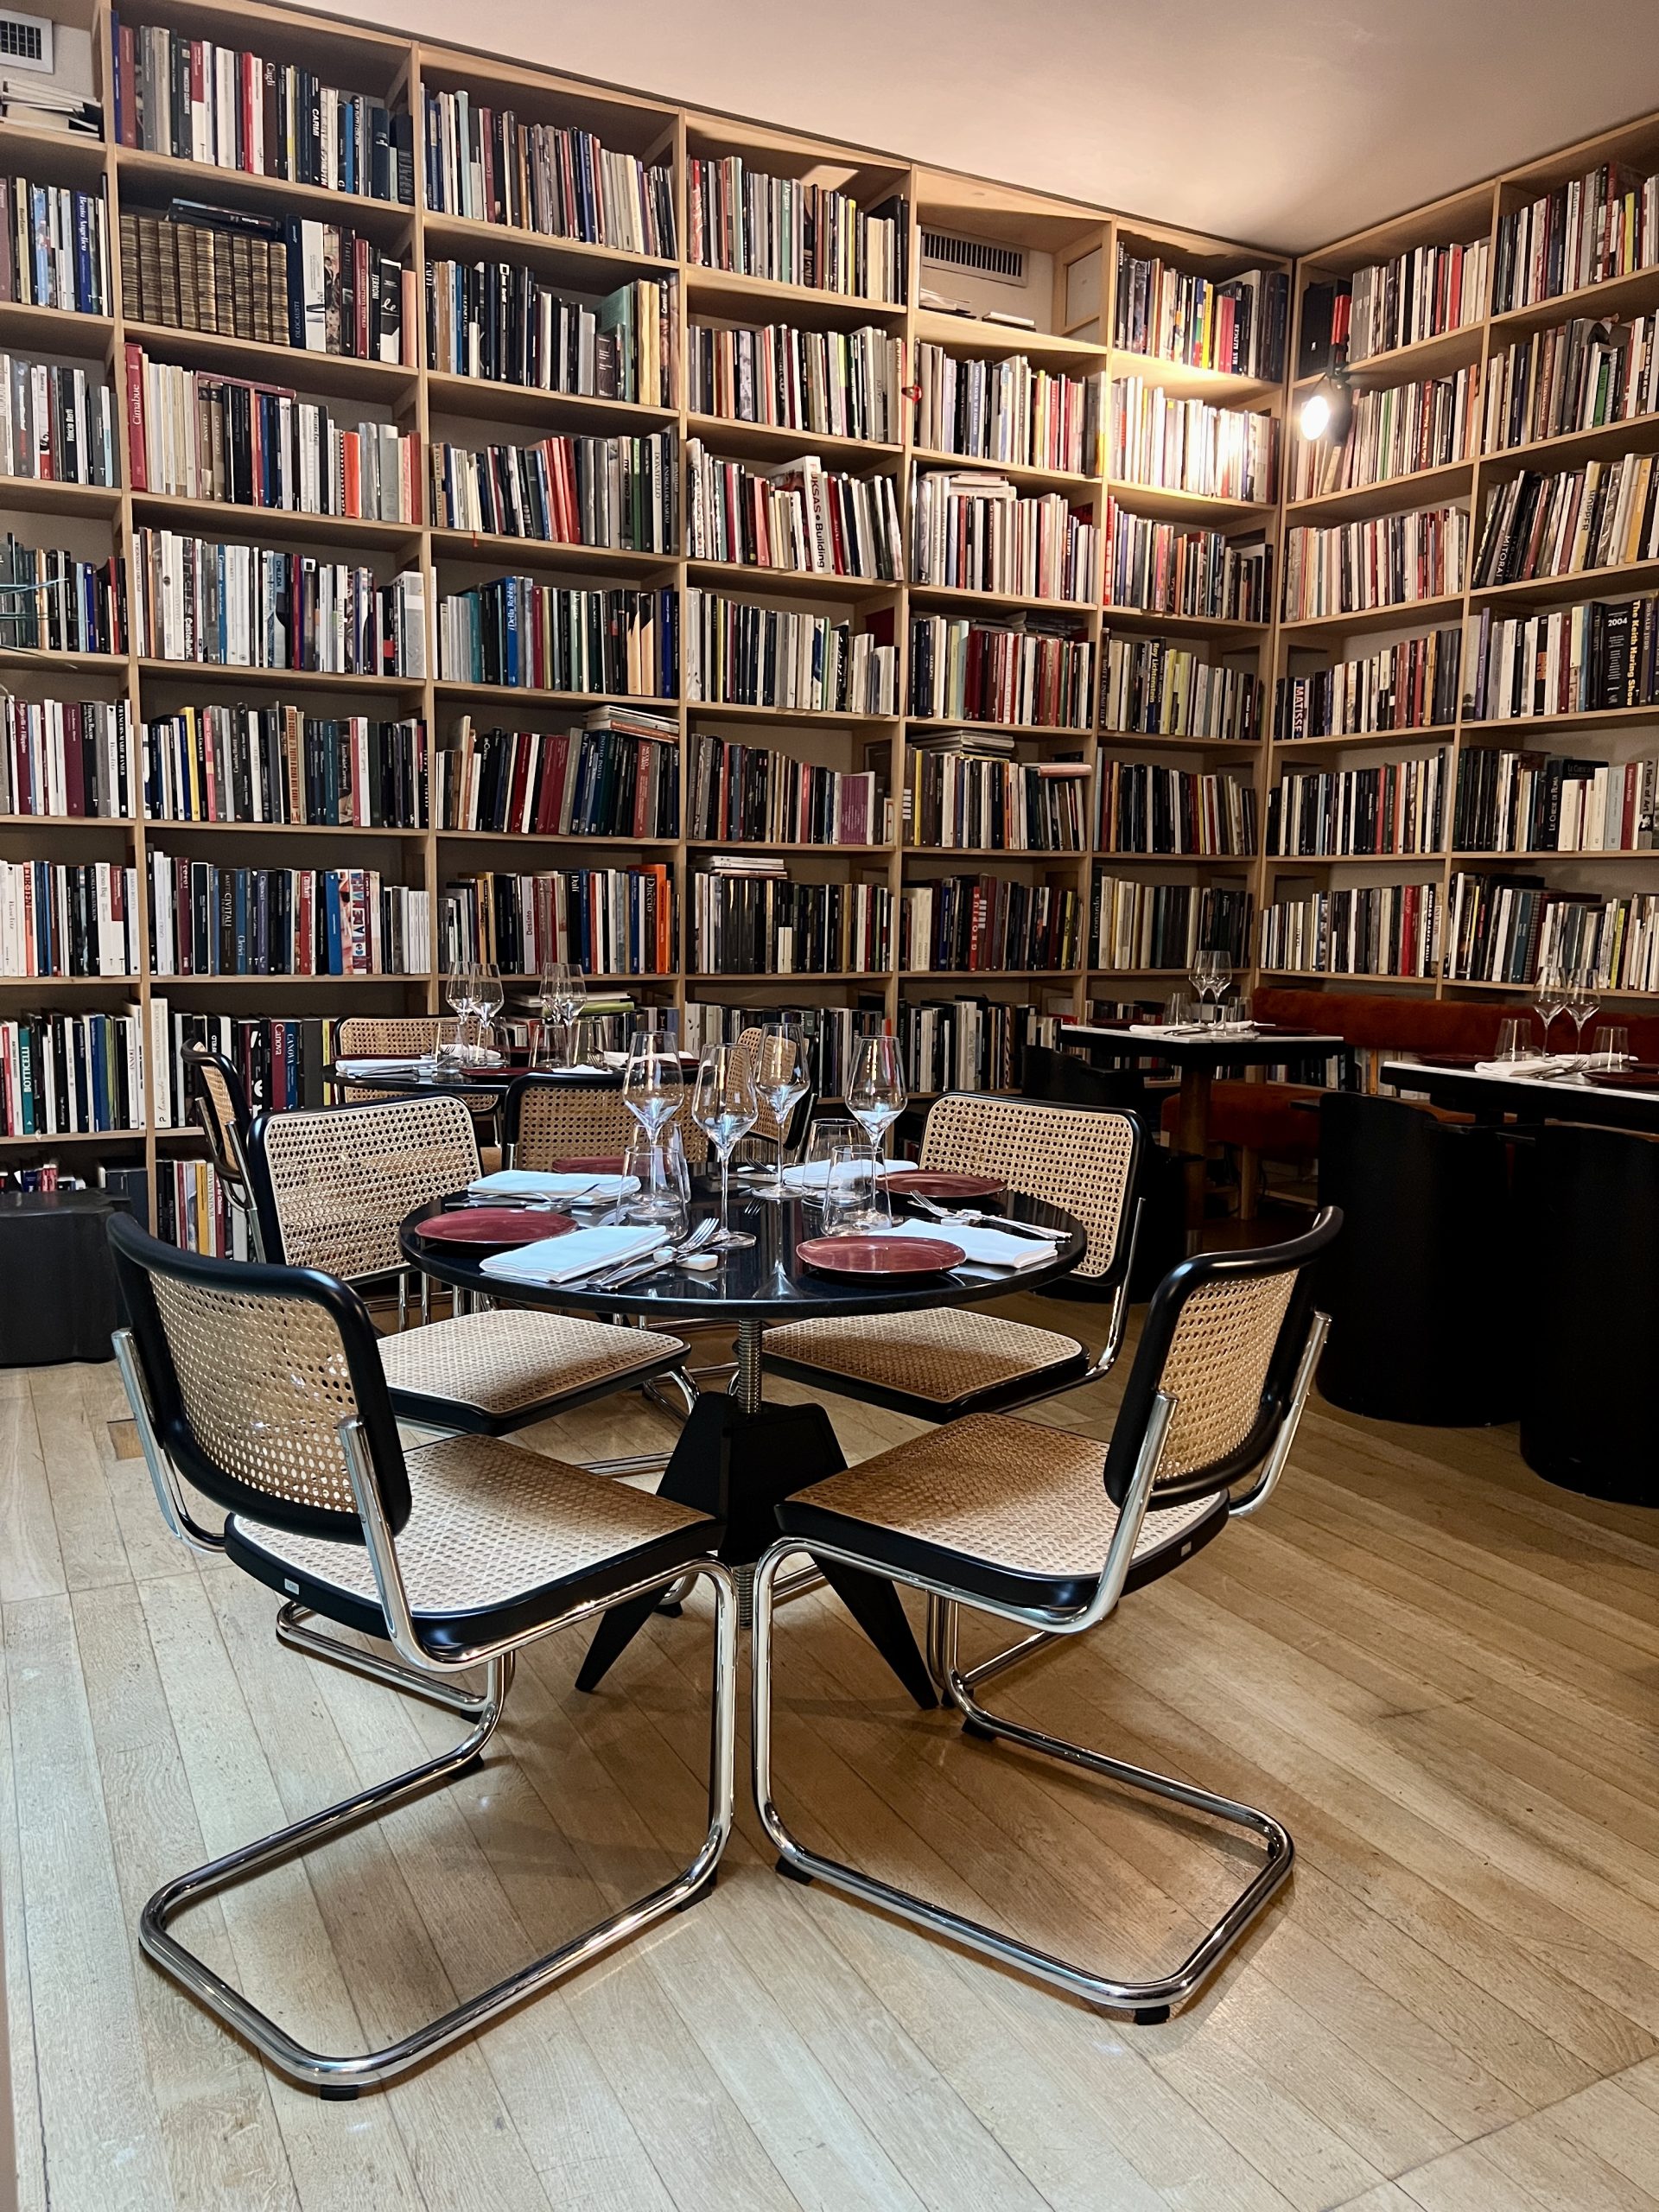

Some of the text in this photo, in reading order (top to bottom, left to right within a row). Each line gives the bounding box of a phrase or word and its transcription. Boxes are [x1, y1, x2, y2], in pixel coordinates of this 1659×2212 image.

[264, 63, 276, 86] Cagli
[782, 182, 791, 211] Degas
[79, 196, 88, 251] Beato Angelico
[372, 274, 380, 299] FERRONI
[130, 384, 142, 424] Cimabue
[1581, 489, 1596, 531] HOPPER
[814, 523, 825, 569] Building
[507, 608, 516, 627] Della
[1607, 617, 1628, 627] 2004
[1626, 600, 1641, 707] The Keith Haring Show
[1149, 642, 1160, 704] Roy Lichtenstein
[1294, 685, 1306, 734] MATISSE
[1550, 776, 1559, 793] ROMA
[1644, 768, 1653, 787] Flash
[1644, 789, 1651, 798] of
[99, 887, 108, 898] Baj
[571, 875, 580, 893] Dalí
[646, 877, 656, 912] Duccio
[224, 893, 232, 927] CIVITALI
[971, 893, 981, 950] GROPIUS
[1092, 896, 1101, 939] Leonardo
[237, 935, 246, 957] Clerici
[274, 1023, 285, 1056] Canova
[286, 1033, 296, 1065] CANOVA
[21, 1046, 32, 1093] BOTTICELLI
